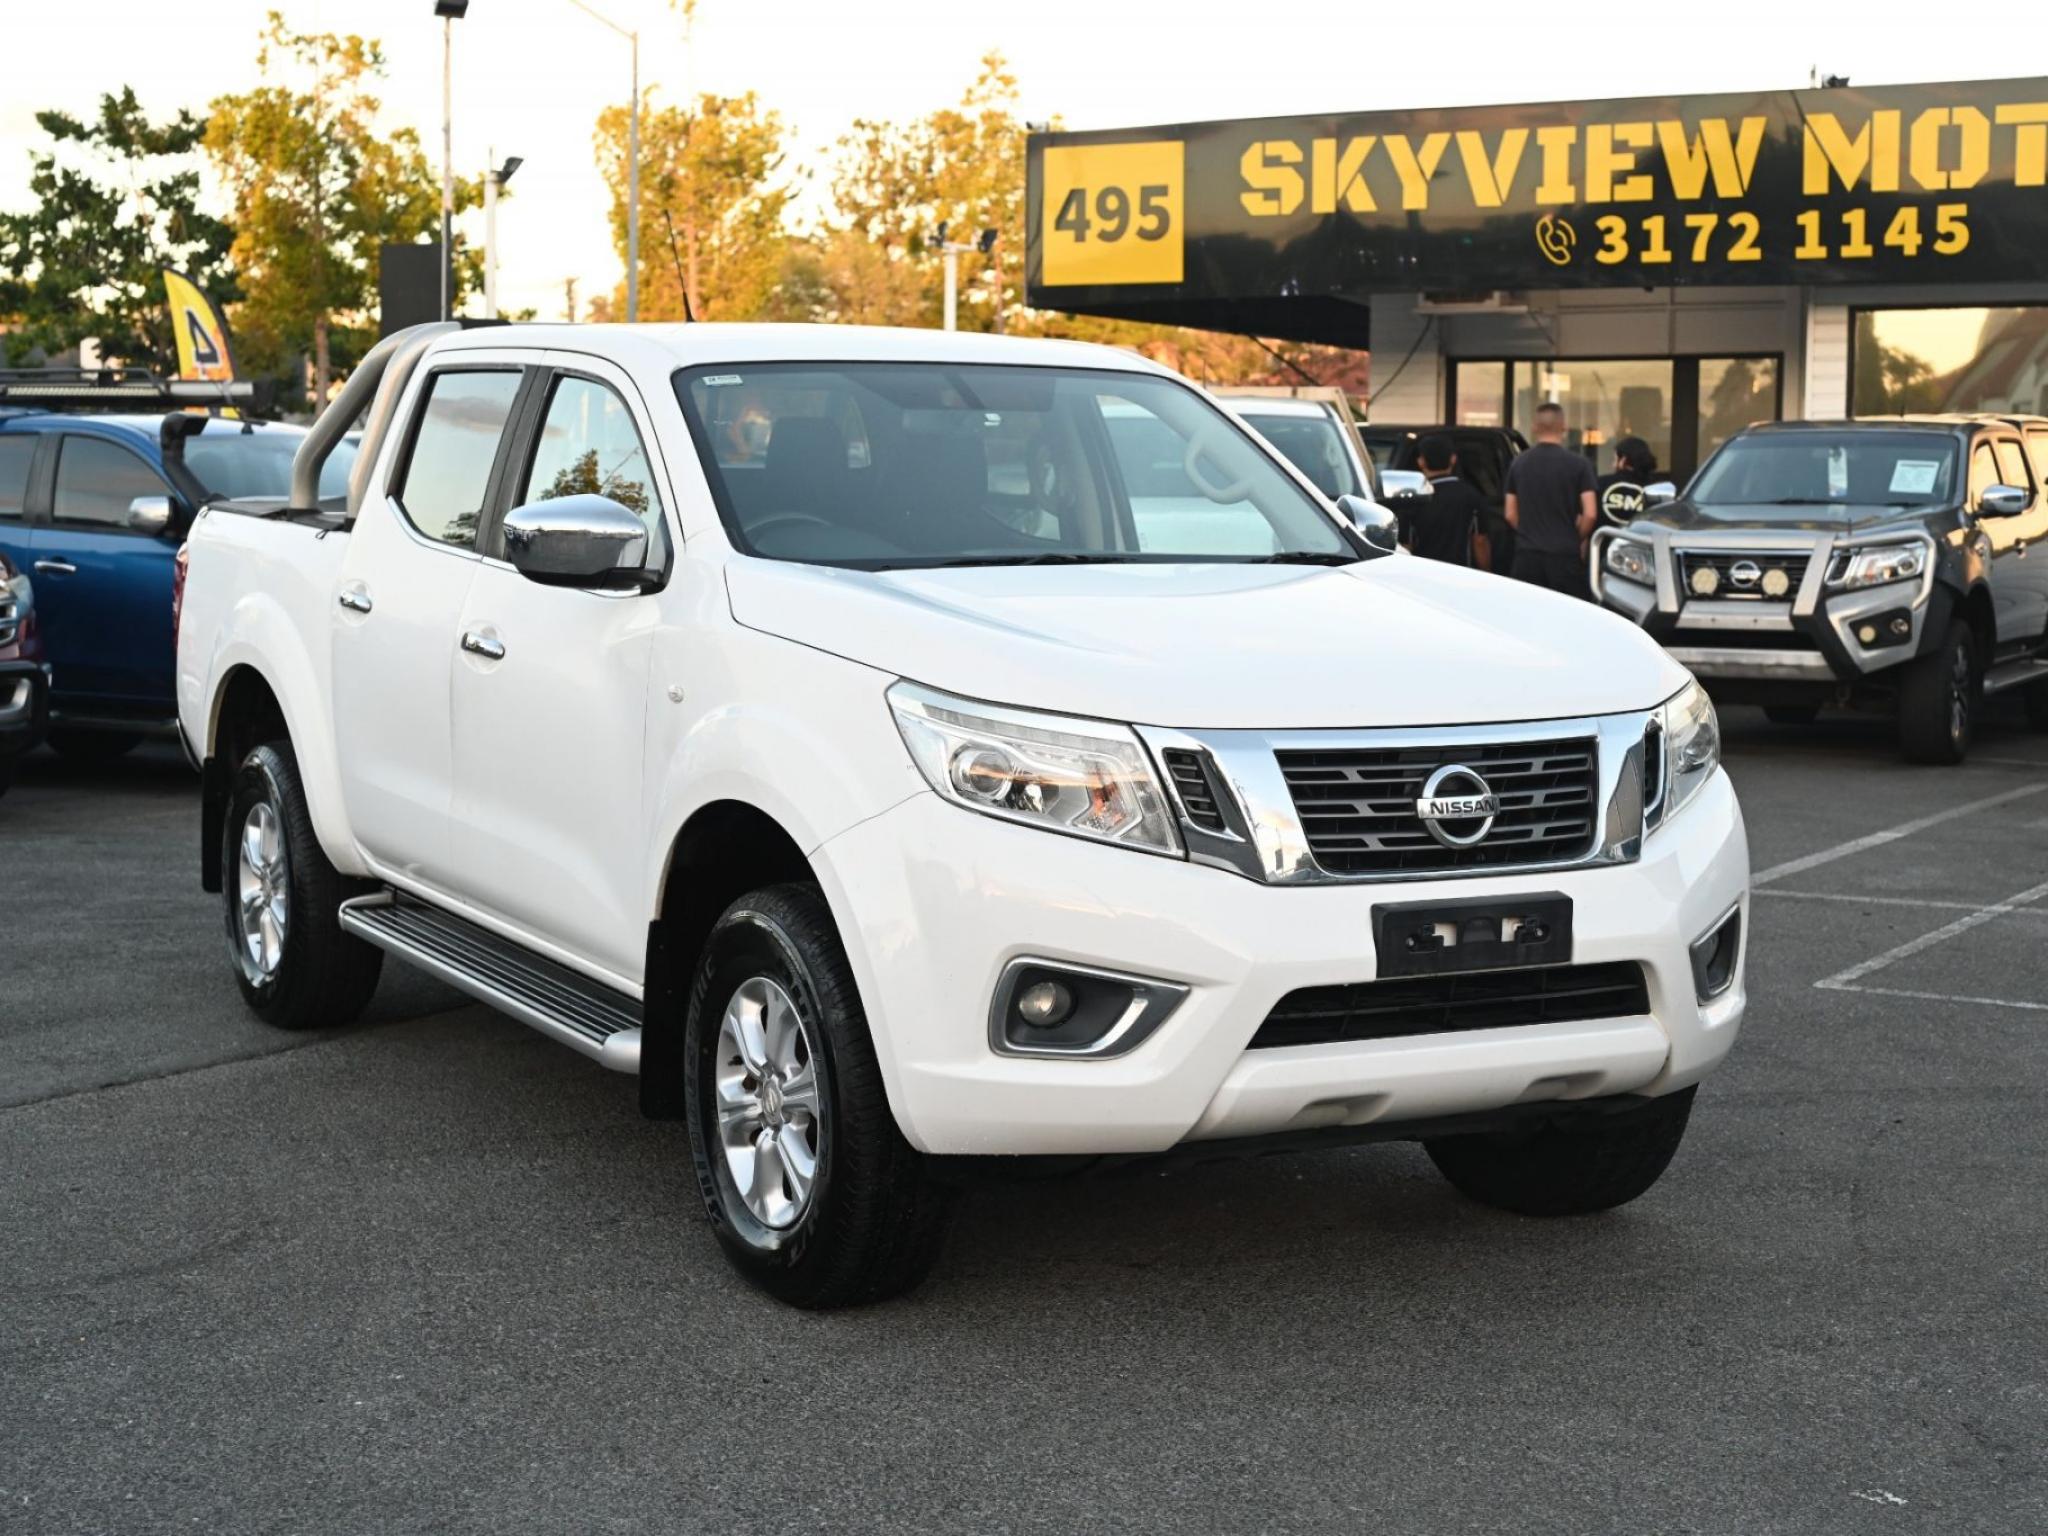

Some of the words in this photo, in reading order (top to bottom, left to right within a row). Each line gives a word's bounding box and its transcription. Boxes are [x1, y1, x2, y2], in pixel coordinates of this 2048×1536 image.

[1239, 116, 1768, 216] SKYVIEW
[1054, 184, 1171, 243] 495
[1595, 210, 1762, 264] 3172
[1795, 203, 1970, 260] 1145
[1608, 493, 1643, 512] SM
[1429, 799, 1495, 815] NISSAN
